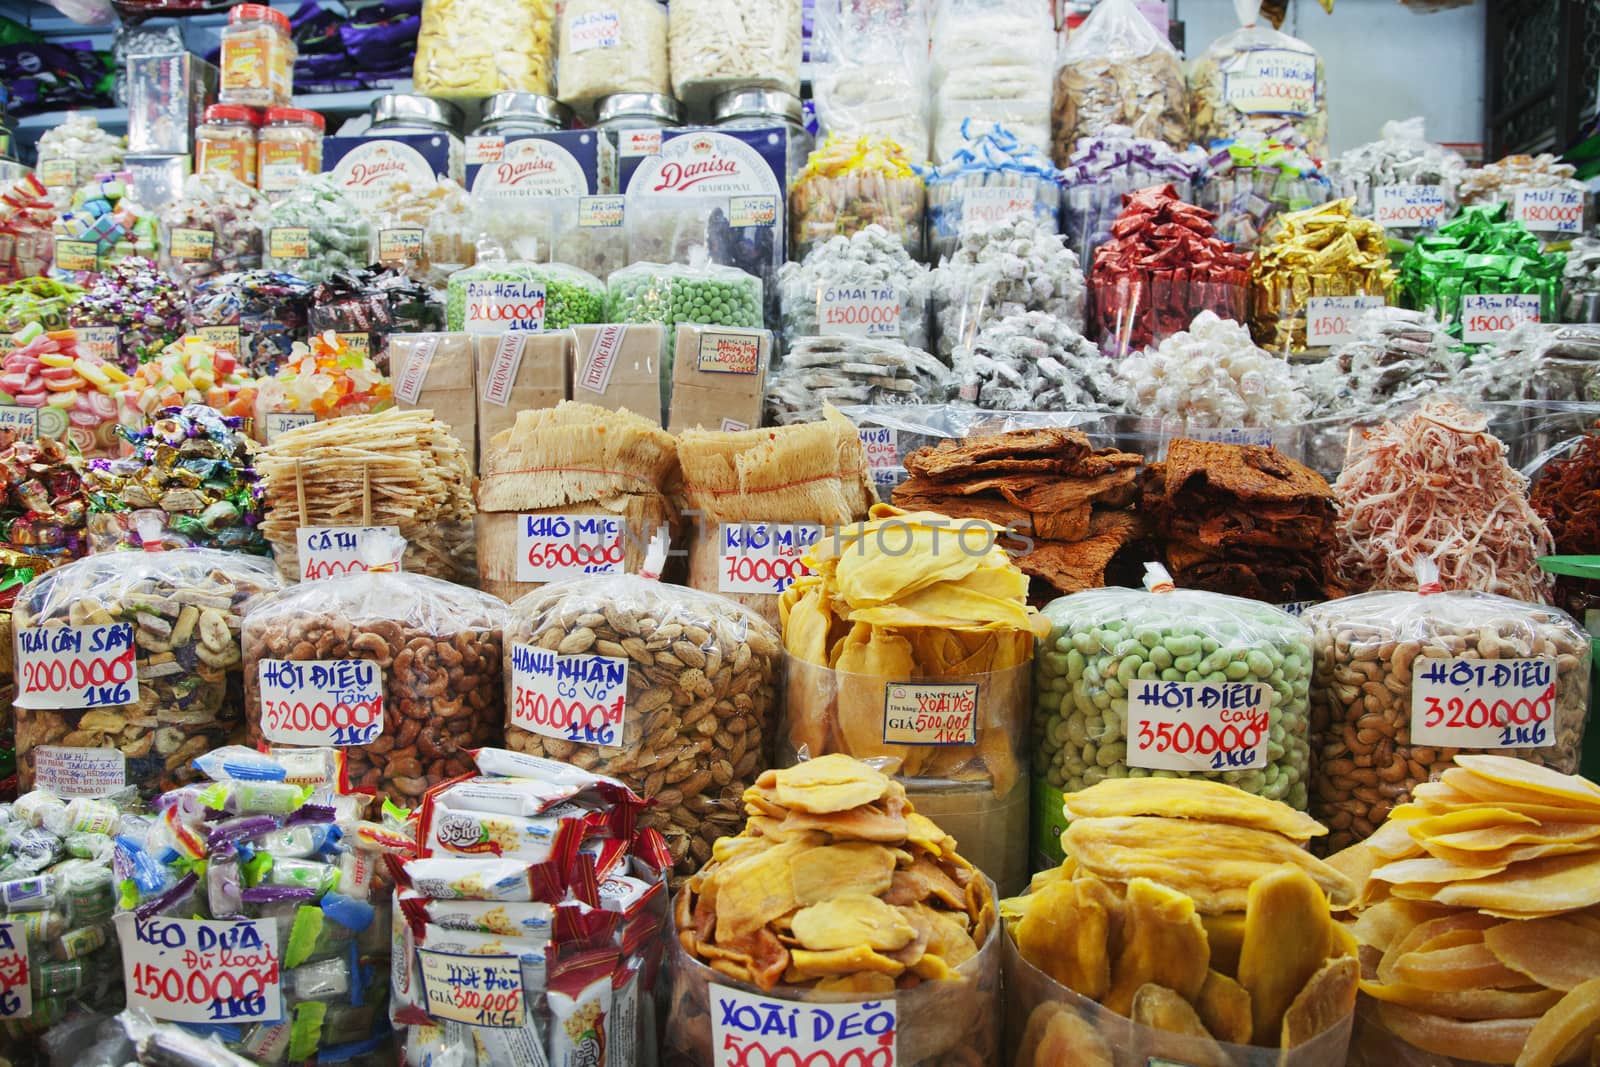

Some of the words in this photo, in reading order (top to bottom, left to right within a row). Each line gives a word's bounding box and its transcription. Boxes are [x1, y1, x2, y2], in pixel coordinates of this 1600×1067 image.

[345, 157, 407, 186] Danisa
[498, 156, 556, 185] Danisa
[654, 155, 740, 191] Danisa
[308, 529, 332, 550] CÁ
[527, 515, 571, 538] KHÔ
[727, 525, 770, 549] KHÔ
[19, 628, 49, 654] TRÁI
[51, 626, 81, 654] CÂY
[89, 622, 132, 652] SẤY
[512, 646, 555, 680] HẠNH
[1420, 661, 1487, 693] HỘT
[1487, 661, 1551, 688] ĐIỀU
[1137, 681, 1194, 713] HỘT
[1197, 683, 1262, 709] ĐIỀU
[134, 917, 187, 955] KẸO
[719, 999, 800, 1039] XOÀI
[810, 1001, 896, 1042] DẺO
